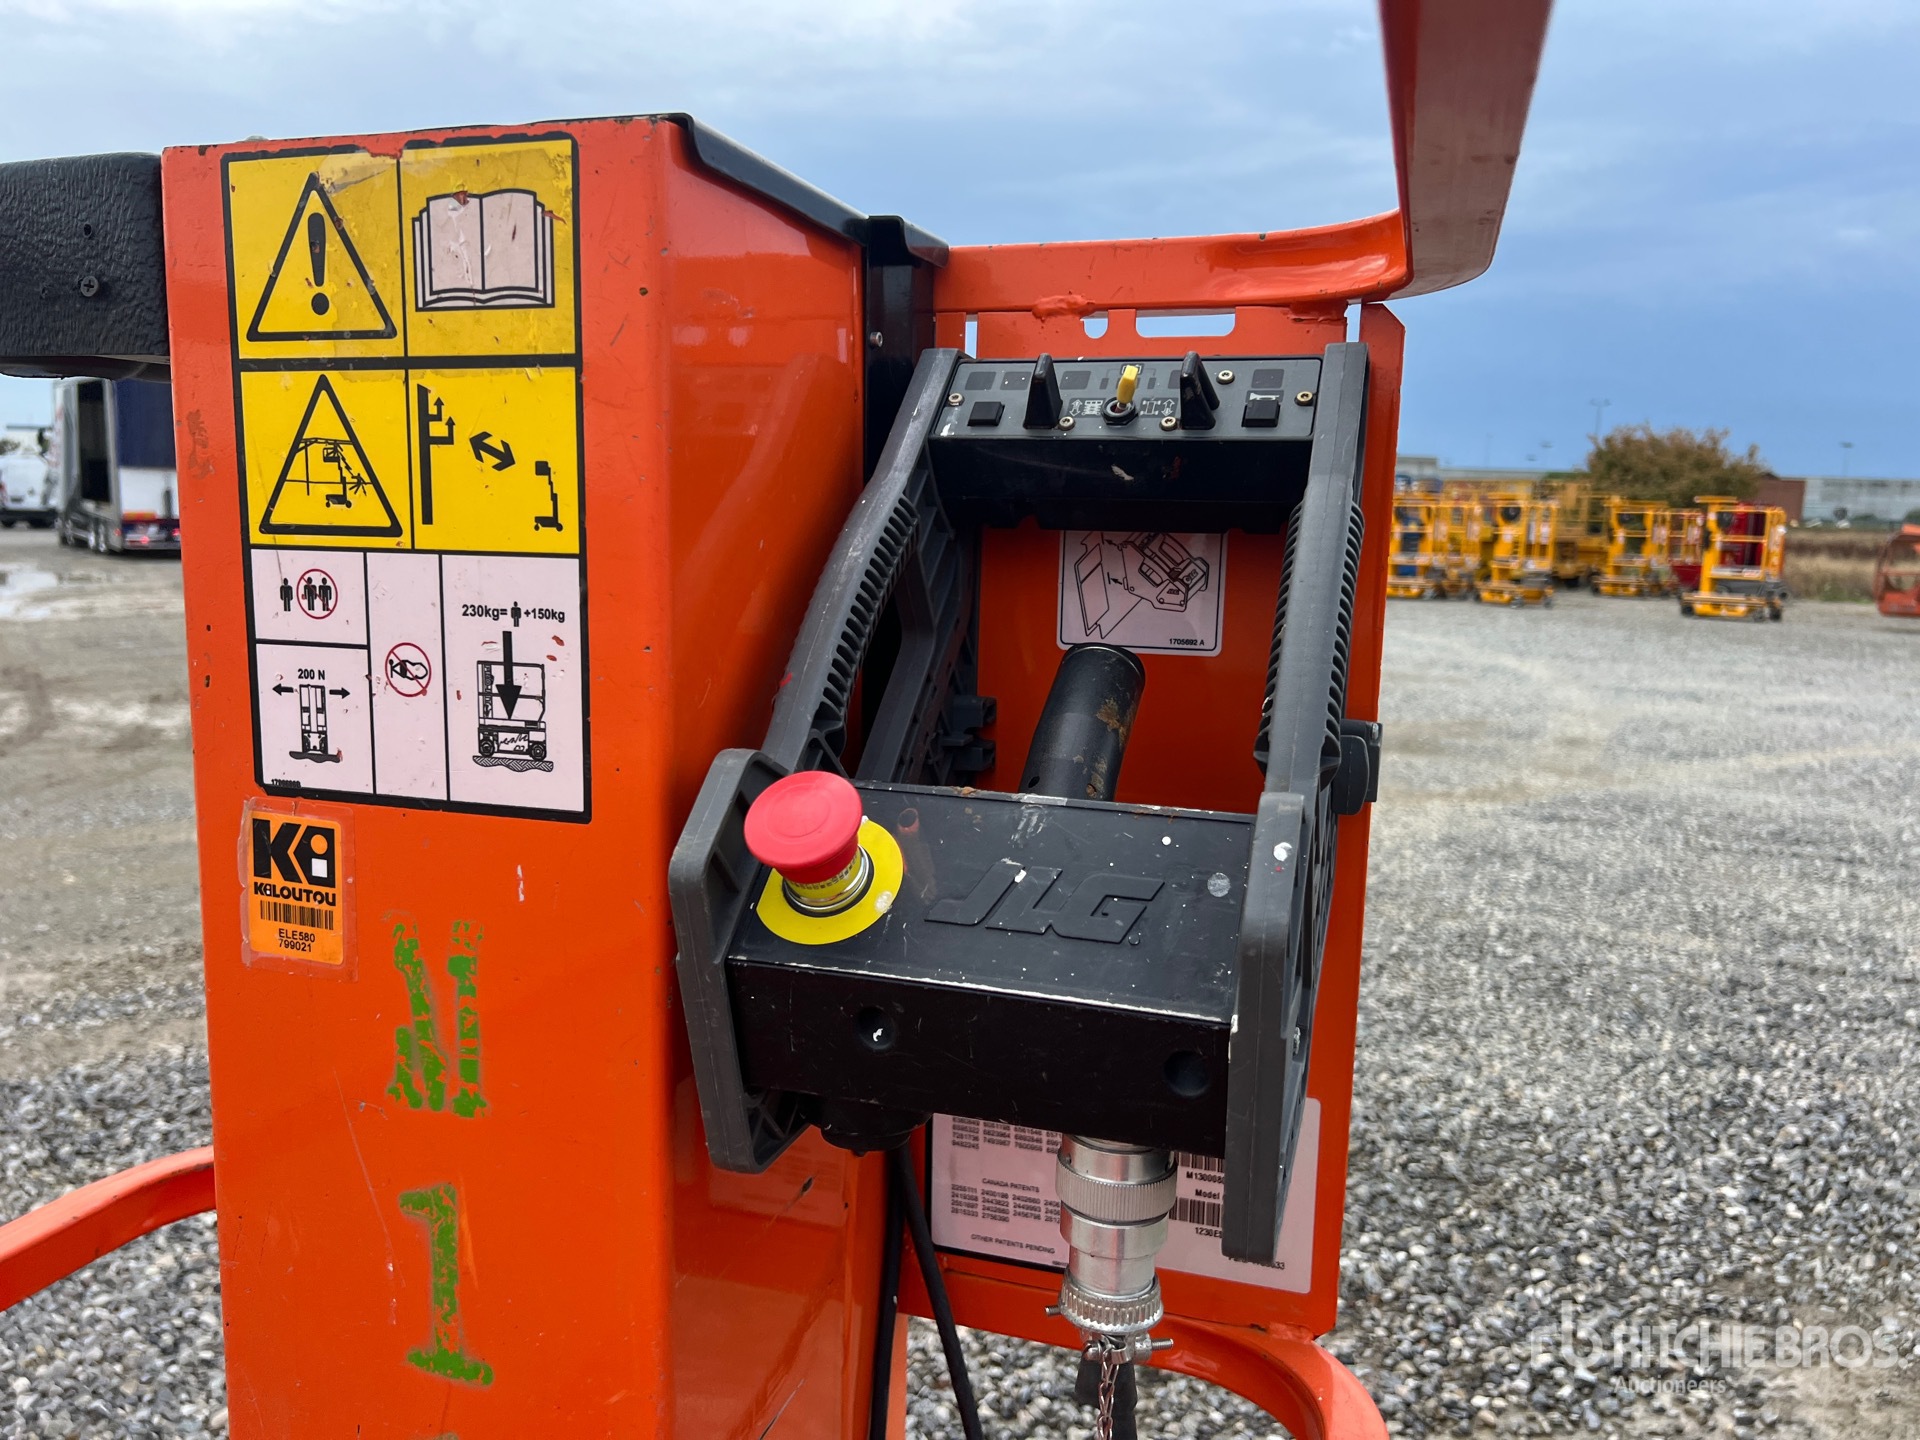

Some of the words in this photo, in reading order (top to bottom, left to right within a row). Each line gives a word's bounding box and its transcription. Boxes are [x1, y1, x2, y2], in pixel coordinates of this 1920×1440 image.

[524, 608, 566, 623] +150kg
[298, 668, 316, 680] 200
[317, 669, 326, 680] N
[925, 860, 1165, 944] JLG
[278, 928, 316, 943] ELE580
[278, 938, 313, 953] 799021
[1186, 1171, 1224, 1183] M130008
[1195, 1189, 1220, 1200] Model
[971, 1233, 994, 1243] OTHER
[995, 1238, 1023, 1249] PATENTS
[1025, 1243, 1055, 1254] PENDING
